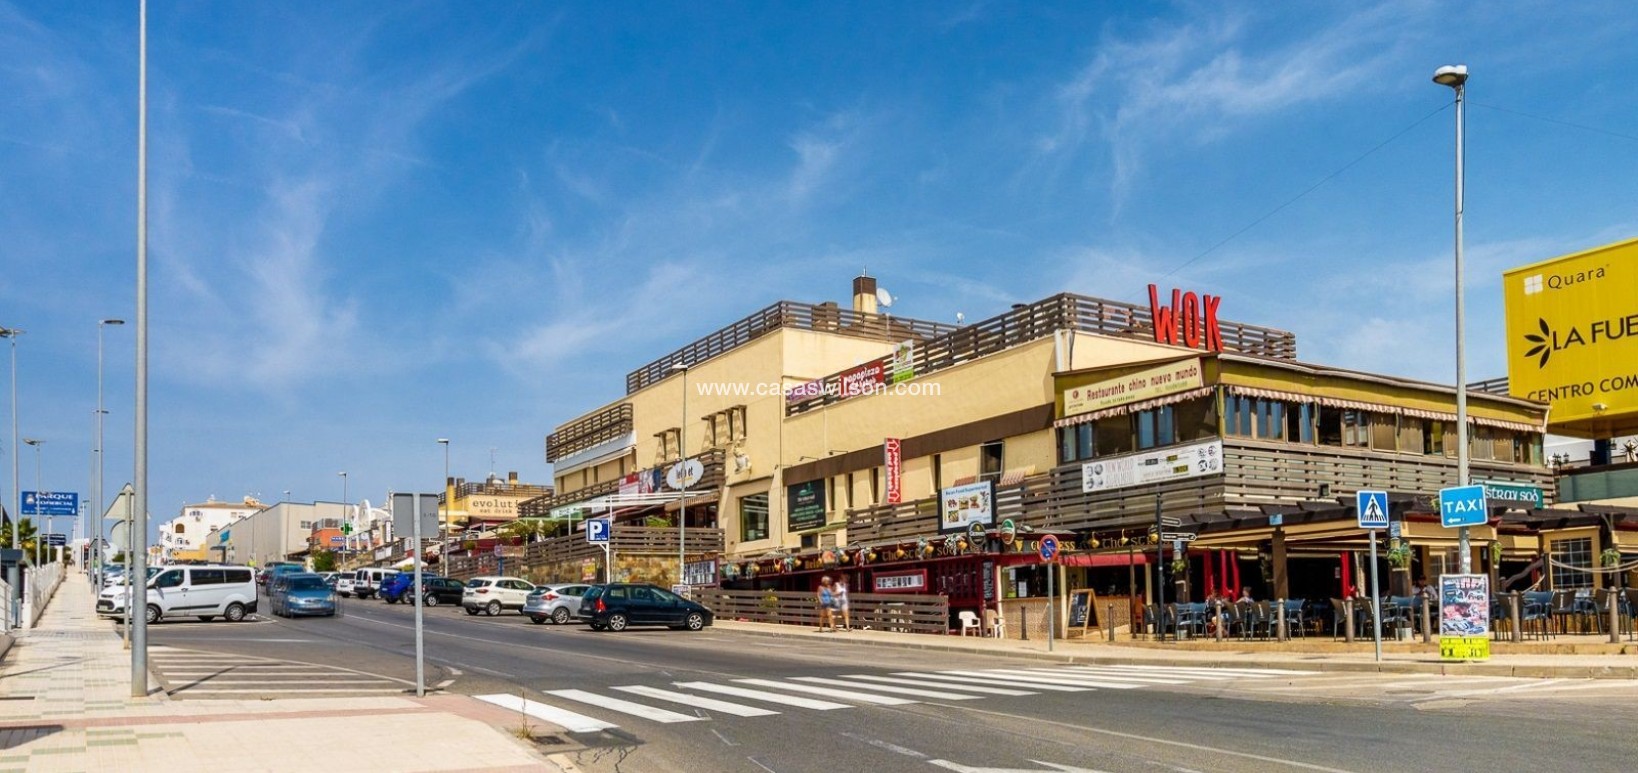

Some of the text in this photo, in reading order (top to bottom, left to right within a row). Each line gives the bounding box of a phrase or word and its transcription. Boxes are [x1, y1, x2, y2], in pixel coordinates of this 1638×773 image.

[1547, 267, 1605, 289] Quara
[1147, 284, 1224, 352] WOK
[1552, 327, 1586, 351] LA
[1086, 382, 1125, 401] Restaurante
[1128, 378, 1147, 390] chino
[1151, 372, 1172, 386] nuevo
[1175, 365, 1198, 380] mundo
[1444, 498, 1483, 514] TAXI
[590, 521, 603, 541] P
